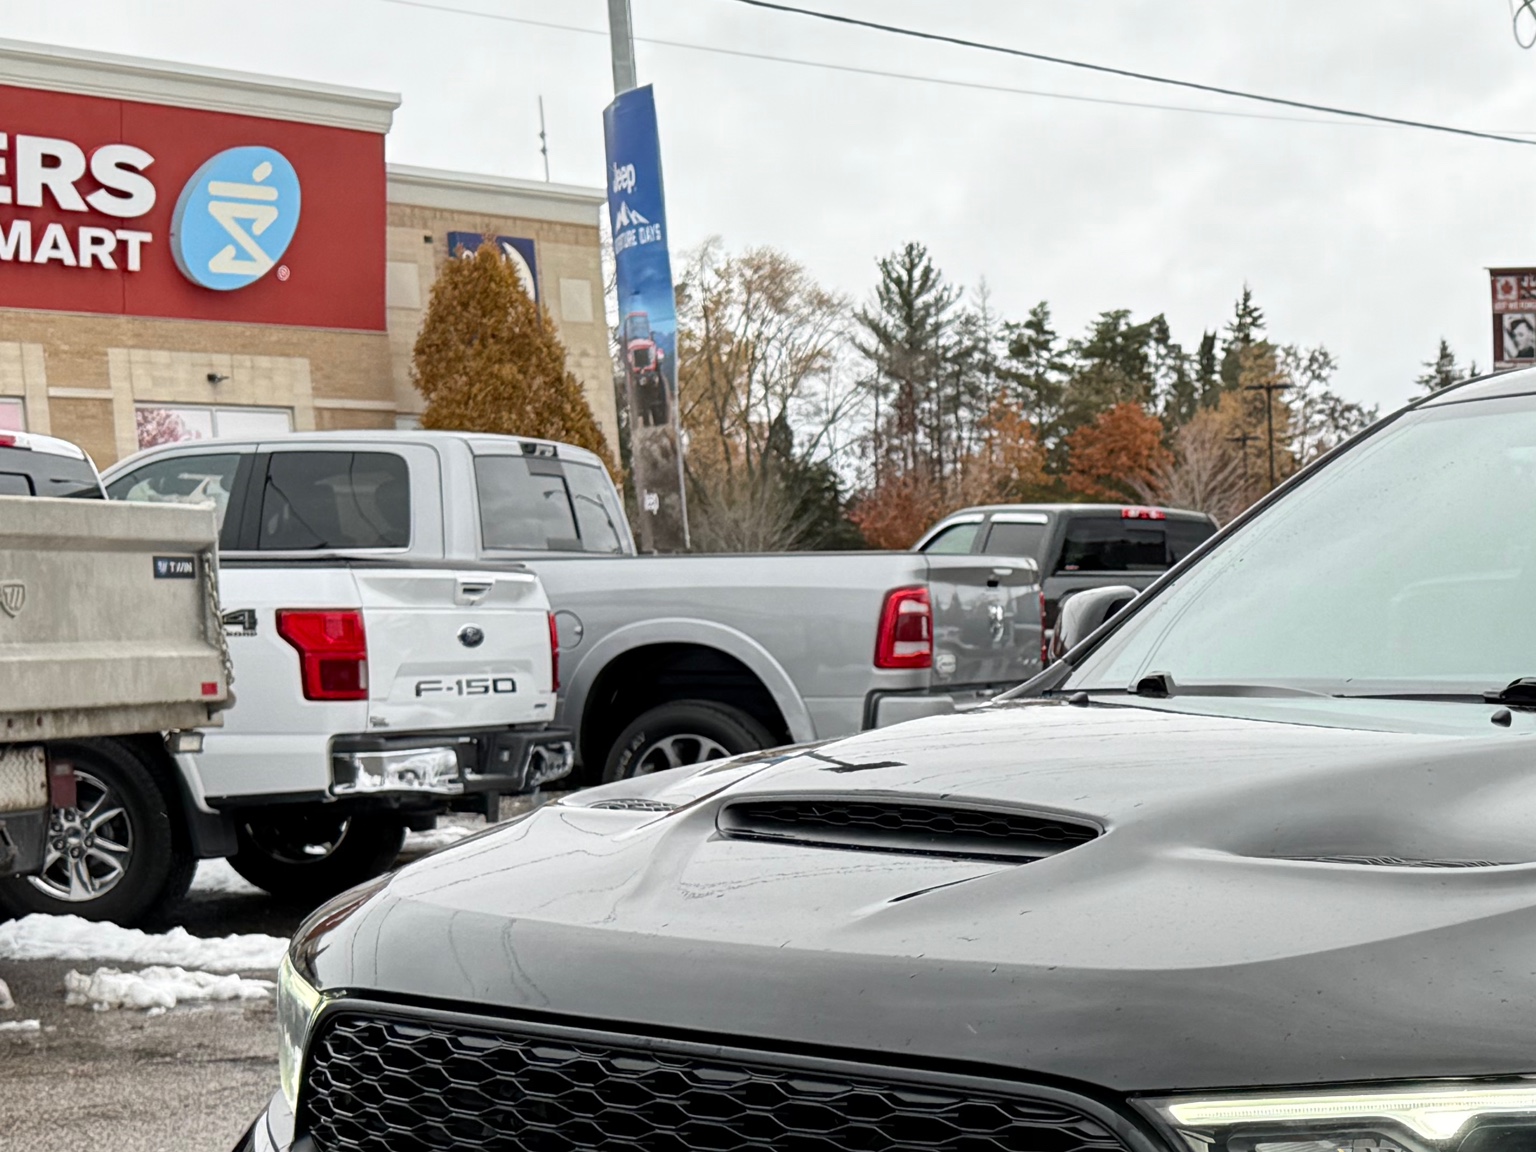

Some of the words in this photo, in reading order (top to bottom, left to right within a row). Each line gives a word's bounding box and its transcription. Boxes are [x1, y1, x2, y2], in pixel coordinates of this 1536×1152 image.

[0, 132, 156, 218] RS
[0, 219, 153, 272] MART
[415, 677, 517, 697] F-150
